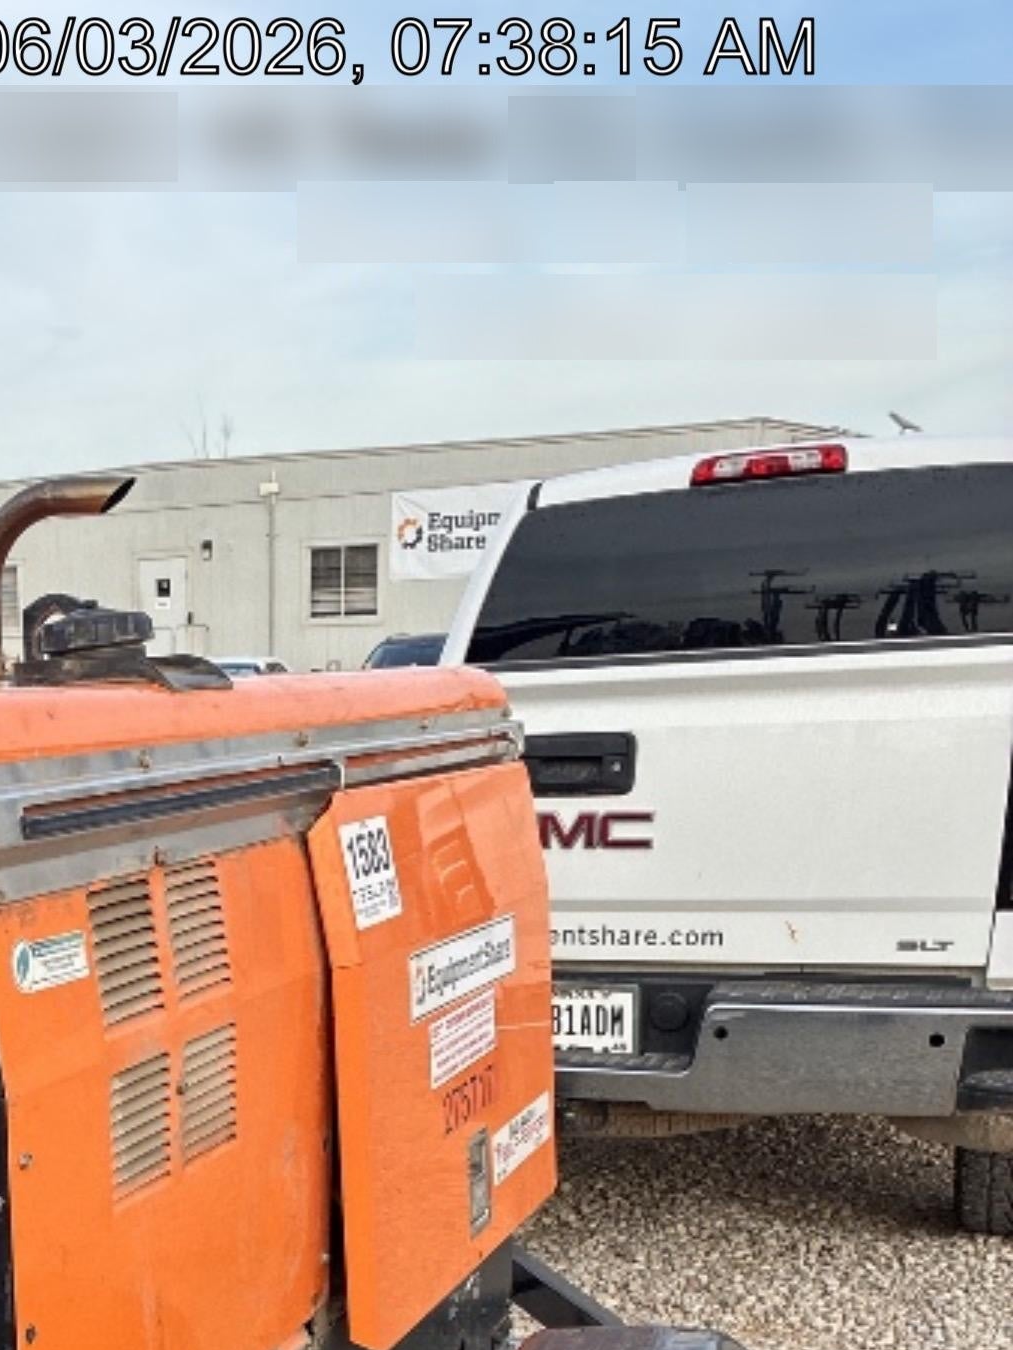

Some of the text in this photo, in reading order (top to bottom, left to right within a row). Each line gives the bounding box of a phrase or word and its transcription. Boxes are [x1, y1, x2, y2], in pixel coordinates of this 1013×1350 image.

[428, 510, 501, 534] Equipm
[427, 532, 486, 553] Share
[538, 811, 655, 850] MC
[347, 828, 390, 880] 1583
[550, 925, 724, 946] entshare.com
[552, 1005, 624, 1036] B1ADM
